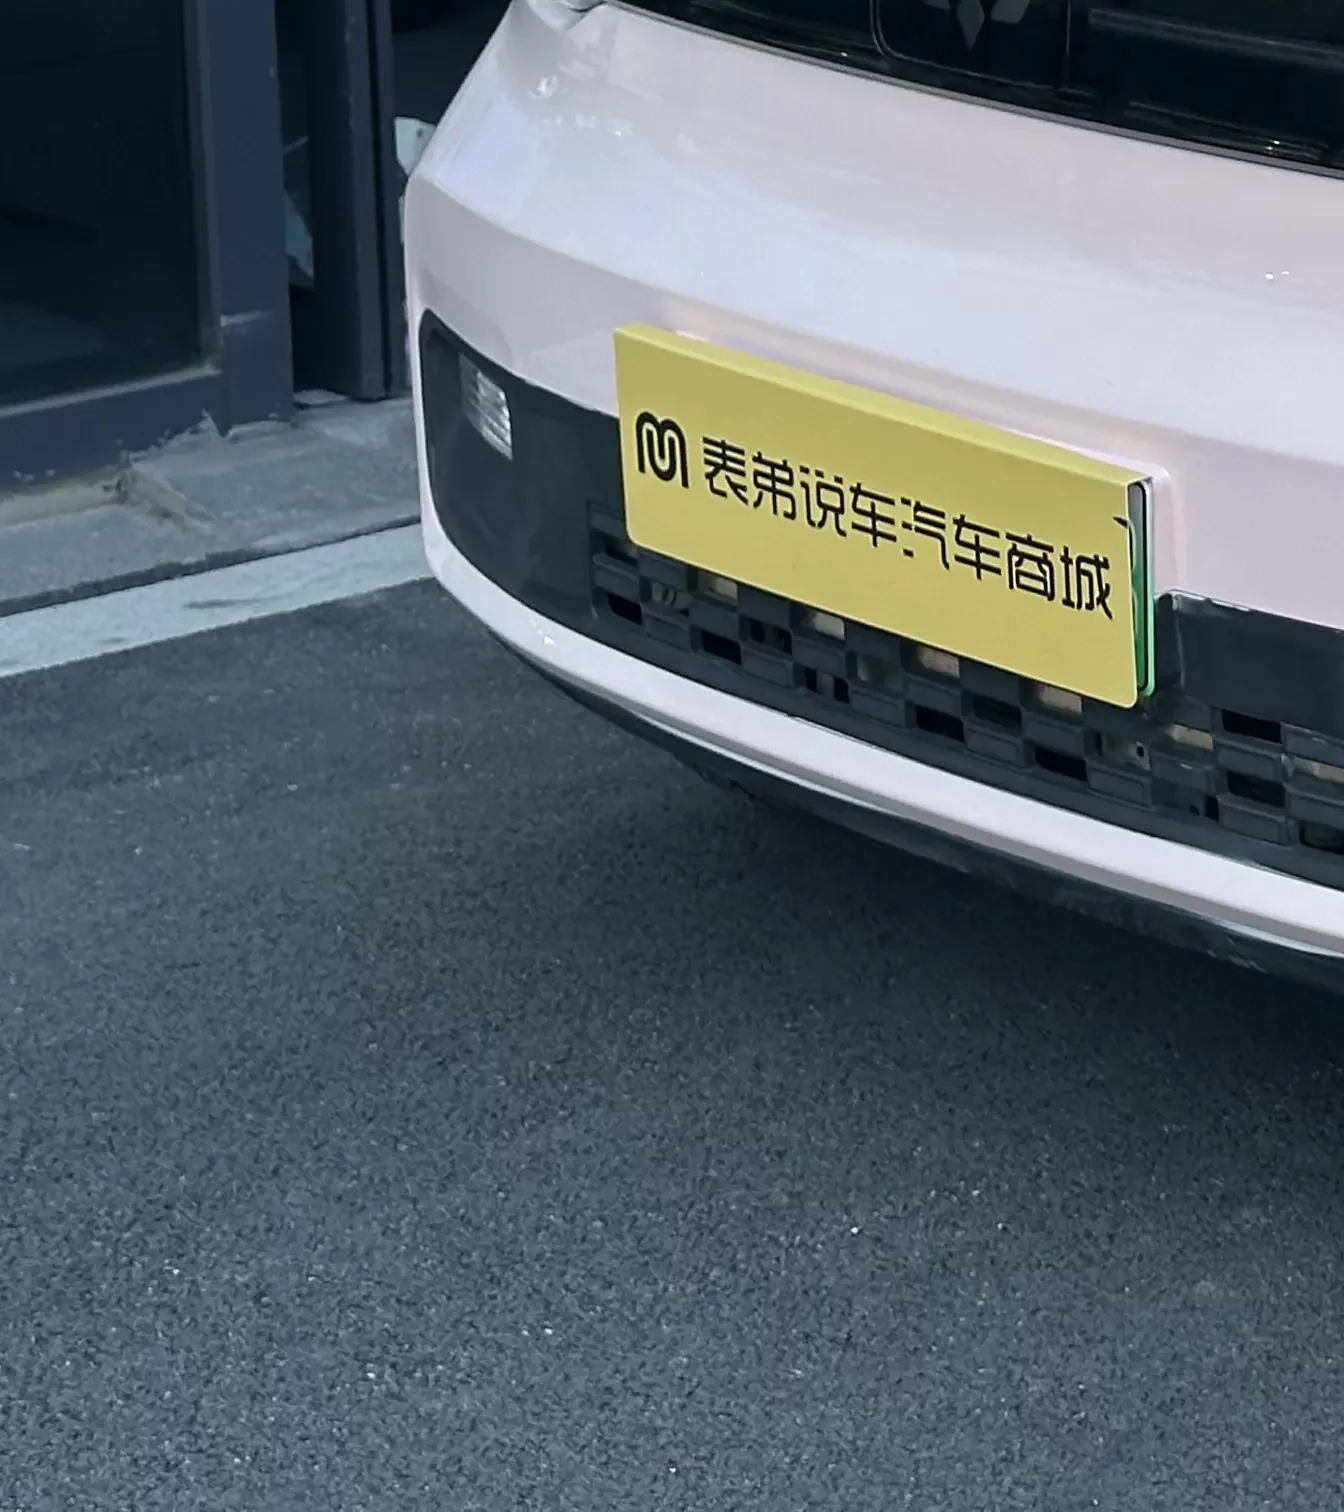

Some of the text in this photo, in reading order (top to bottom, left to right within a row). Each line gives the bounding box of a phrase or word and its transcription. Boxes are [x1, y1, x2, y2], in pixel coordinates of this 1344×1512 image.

[701, 435, 1113, 620] 表弟说车汽车商城
